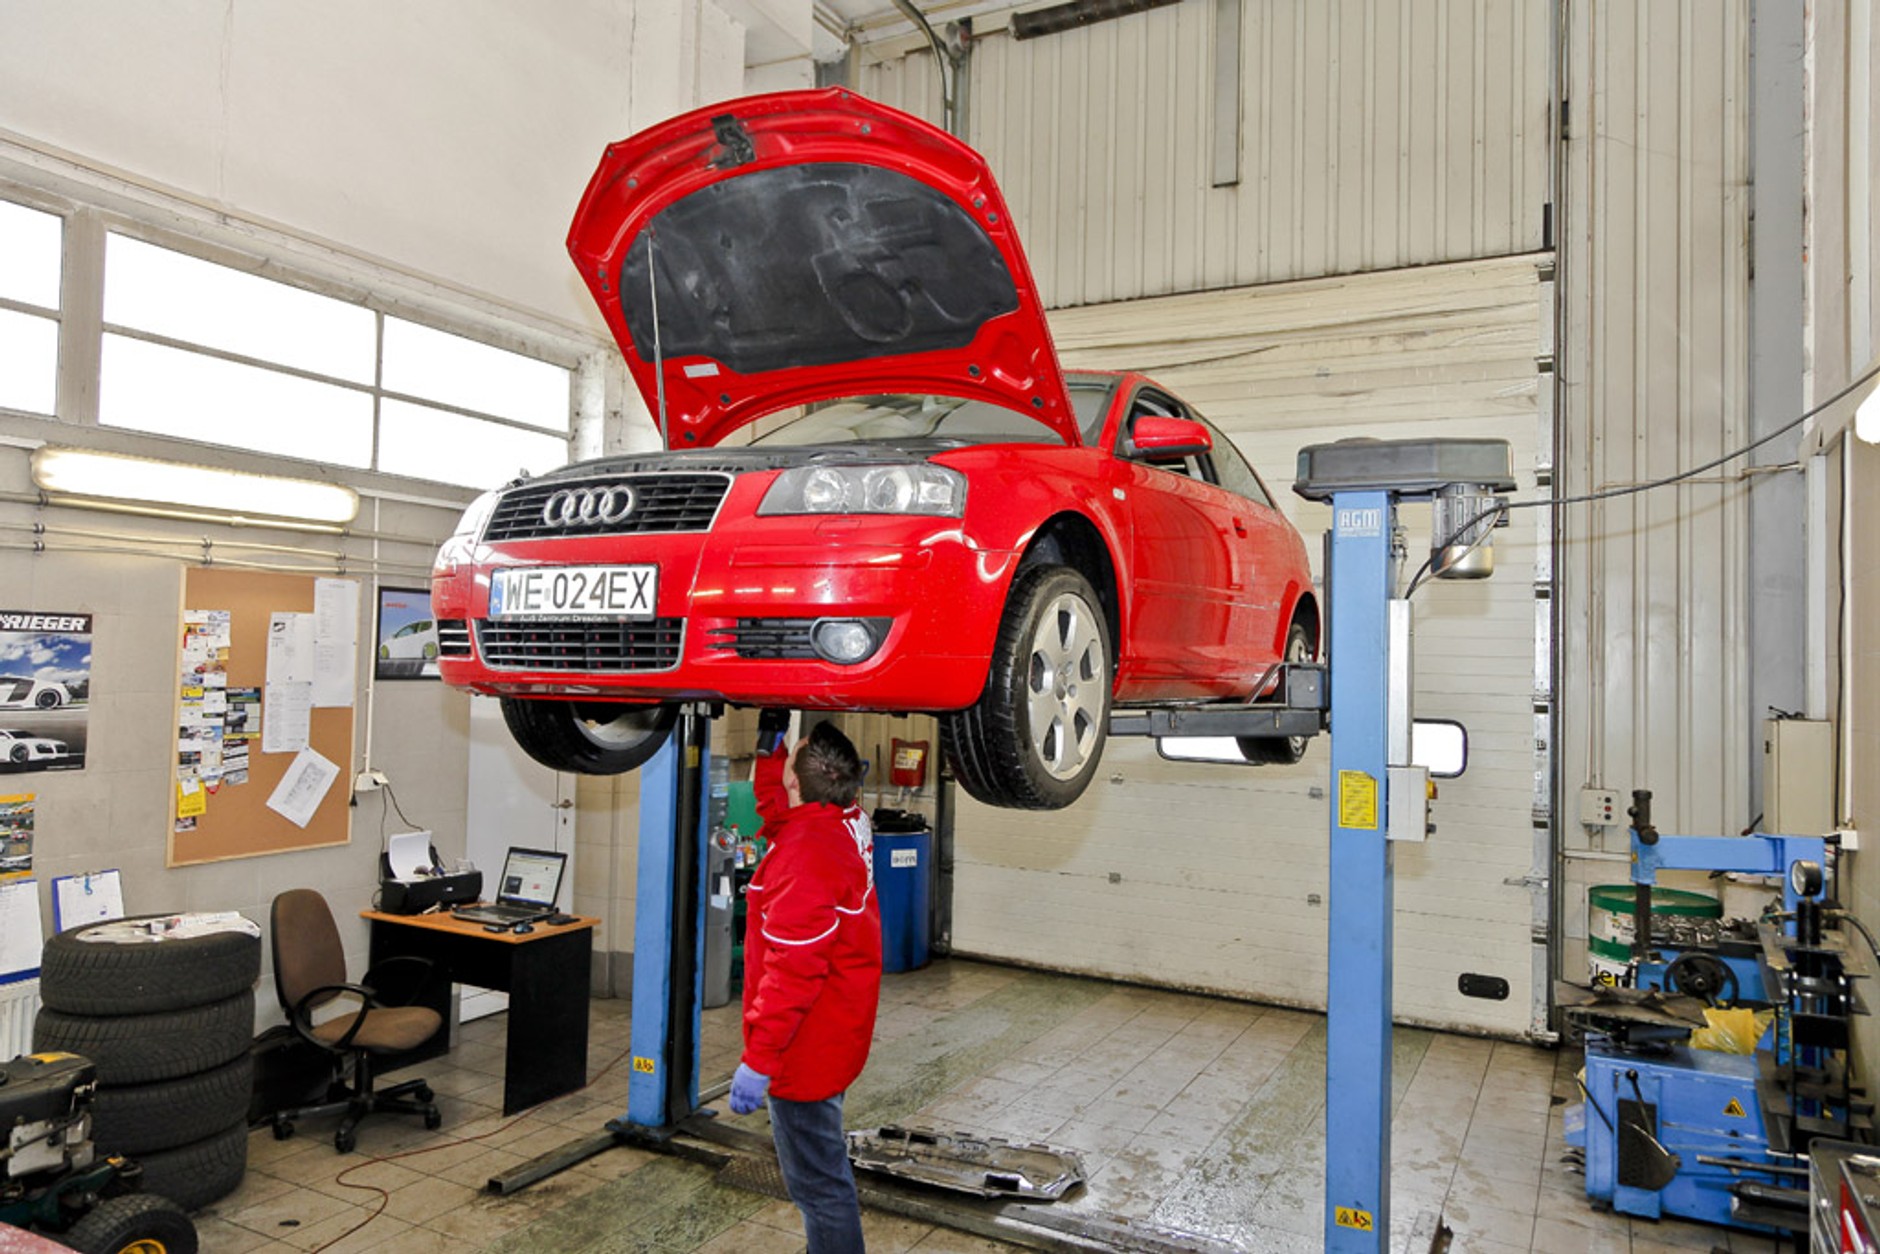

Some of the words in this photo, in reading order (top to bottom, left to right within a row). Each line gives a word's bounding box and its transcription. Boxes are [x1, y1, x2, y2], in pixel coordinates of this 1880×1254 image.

[506, 573, 543, 610] WE
[552, 571, 650, 609] 024EX
[3, 614, 87, 631] RIEGER
